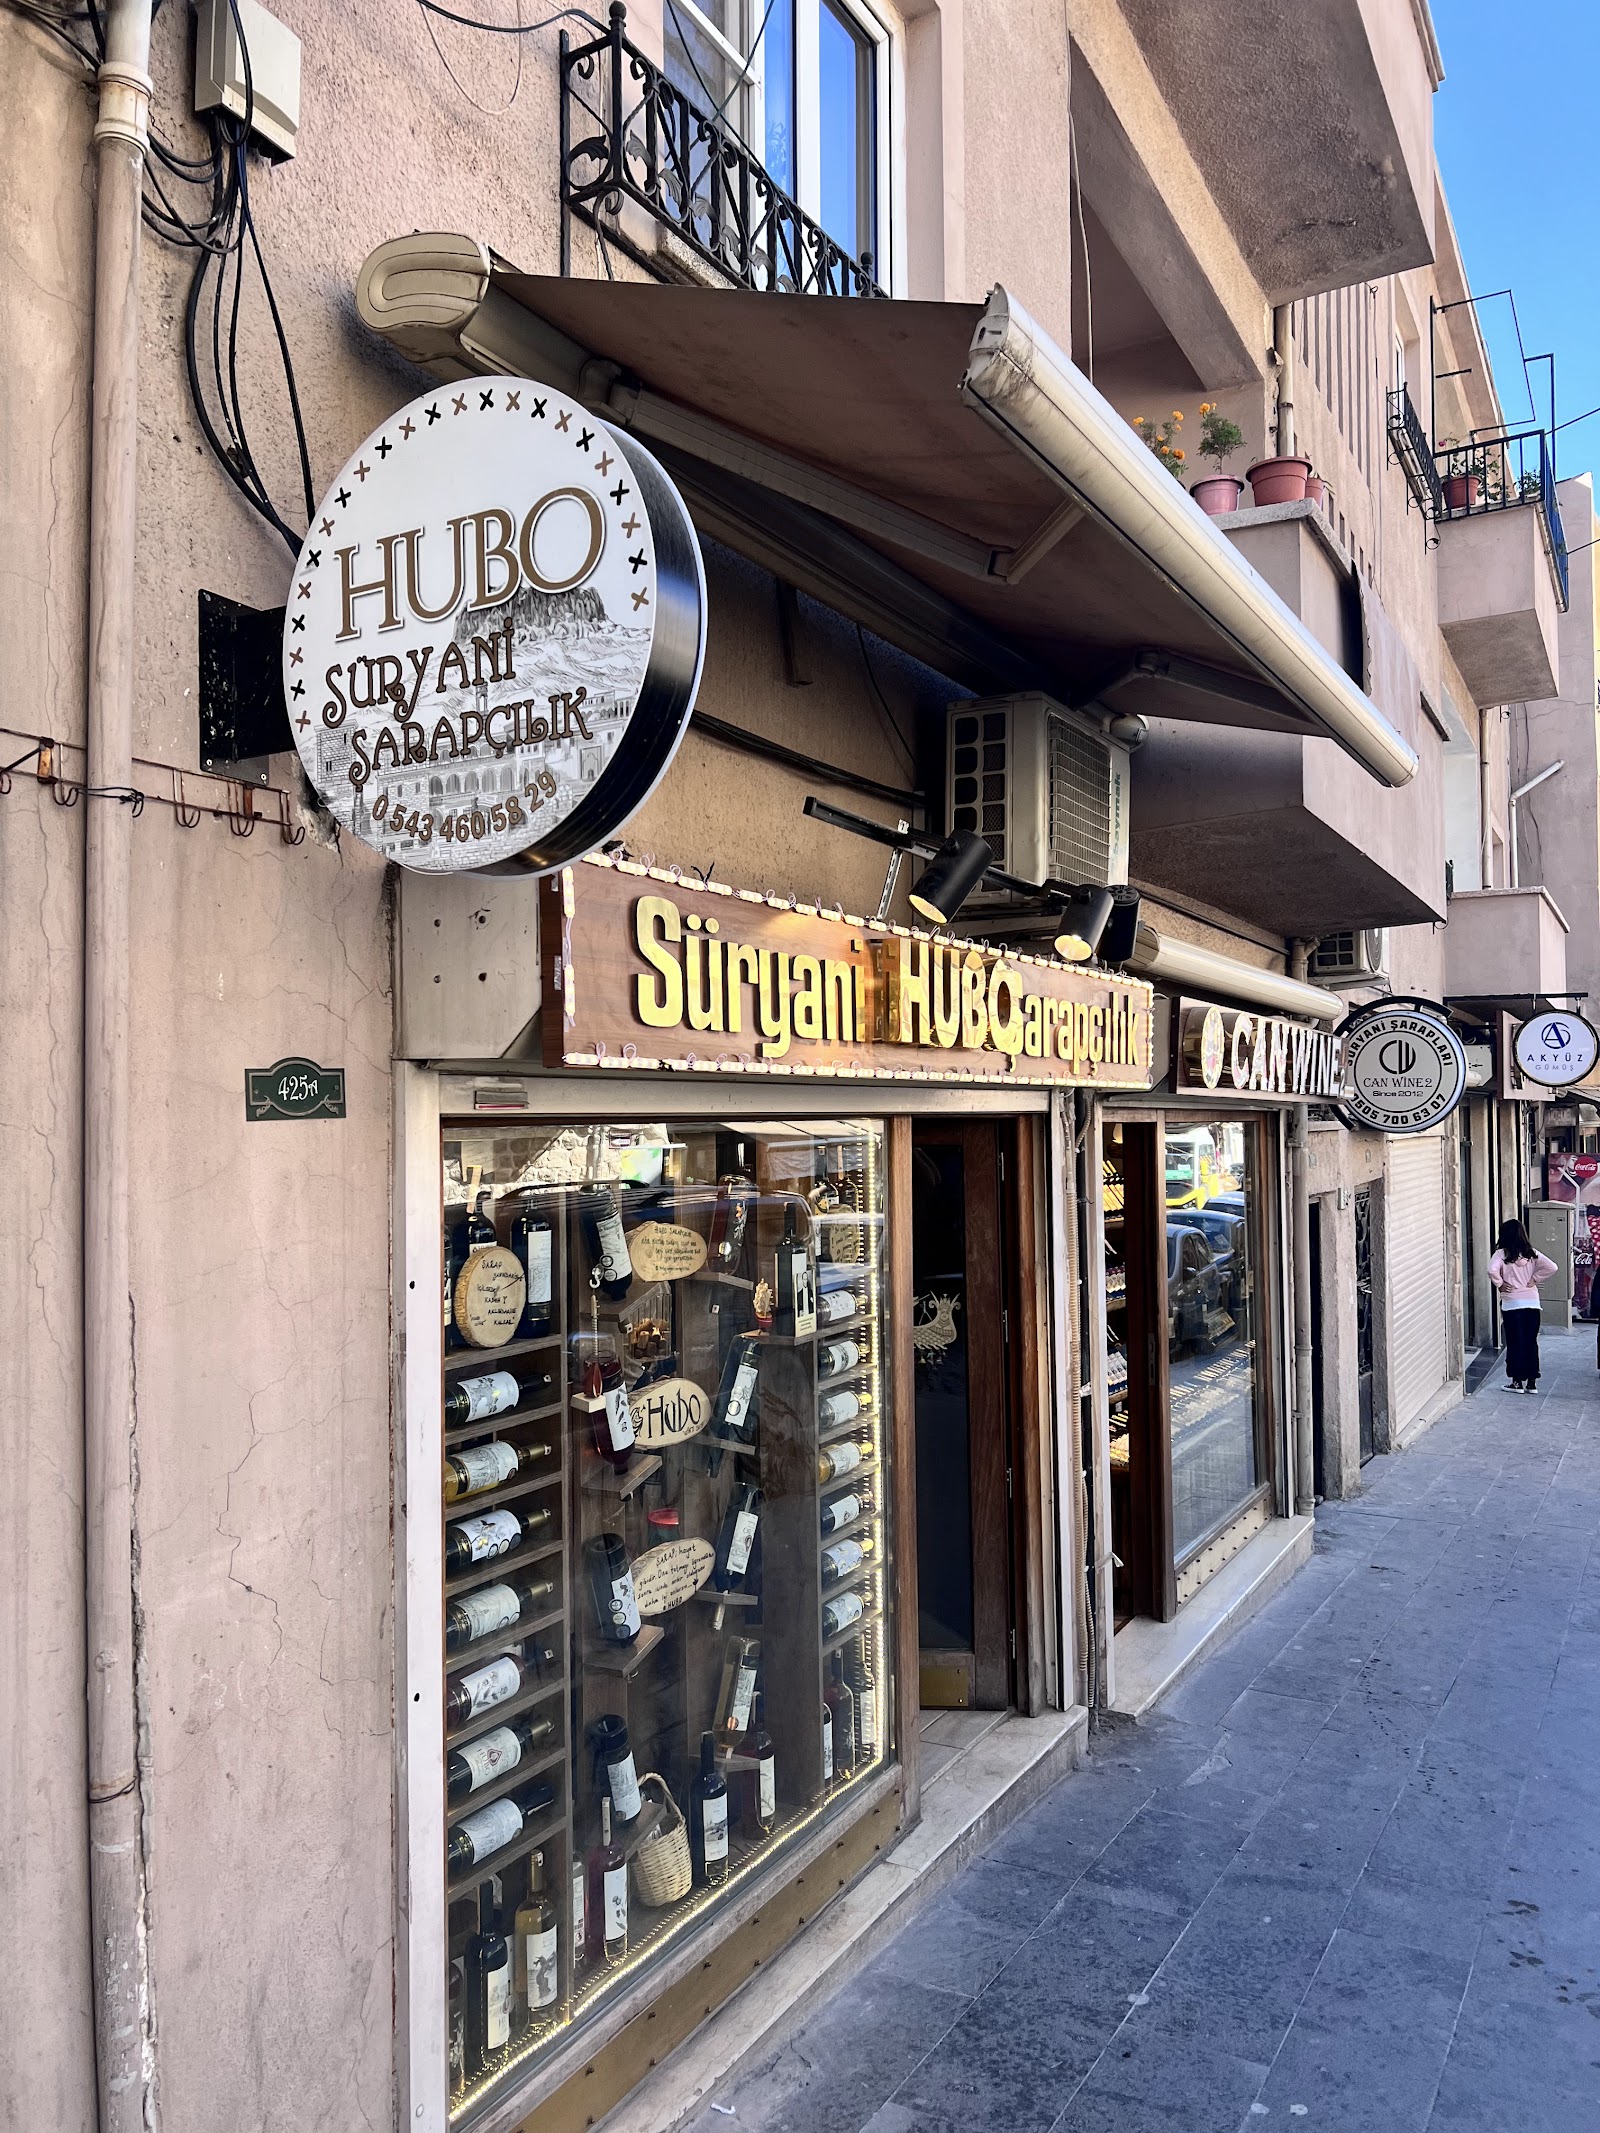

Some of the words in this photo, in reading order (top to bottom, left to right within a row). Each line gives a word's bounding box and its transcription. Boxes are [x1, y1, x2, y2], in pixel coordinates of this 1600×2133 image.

[334, 486, 605, 641] HUBO
[322, 617, 517, 729] SÜRYANİ
[349, 686, 594, 792] ŞARAPÇILIK
[372, 794, 389, 821] 0
[389, 804, 434, 842] 543
[439, 810, 486, 842] 460
[490, 796, 523, 832] 58
[524, 771, 558, 813] 29
[636, 895, 867, 1058] Süryani
[900, 938, 1022, 1053] HUBO
[1231, 1012, 1289, 1093] CAN
[1390, 1019, 1453, 1067] ŞARAPLARI
[1526, 1052, 1583, 1062] AKYÜZ
[278, 1074, 319, 1101] 425A
[1363, 1077, 1388, 1088] CAN
[1383, 1113, 1409, 1125] 700
[1412, 1107, 1431, 1122] 63
[1430, 1093, 1446, 1110] 07
